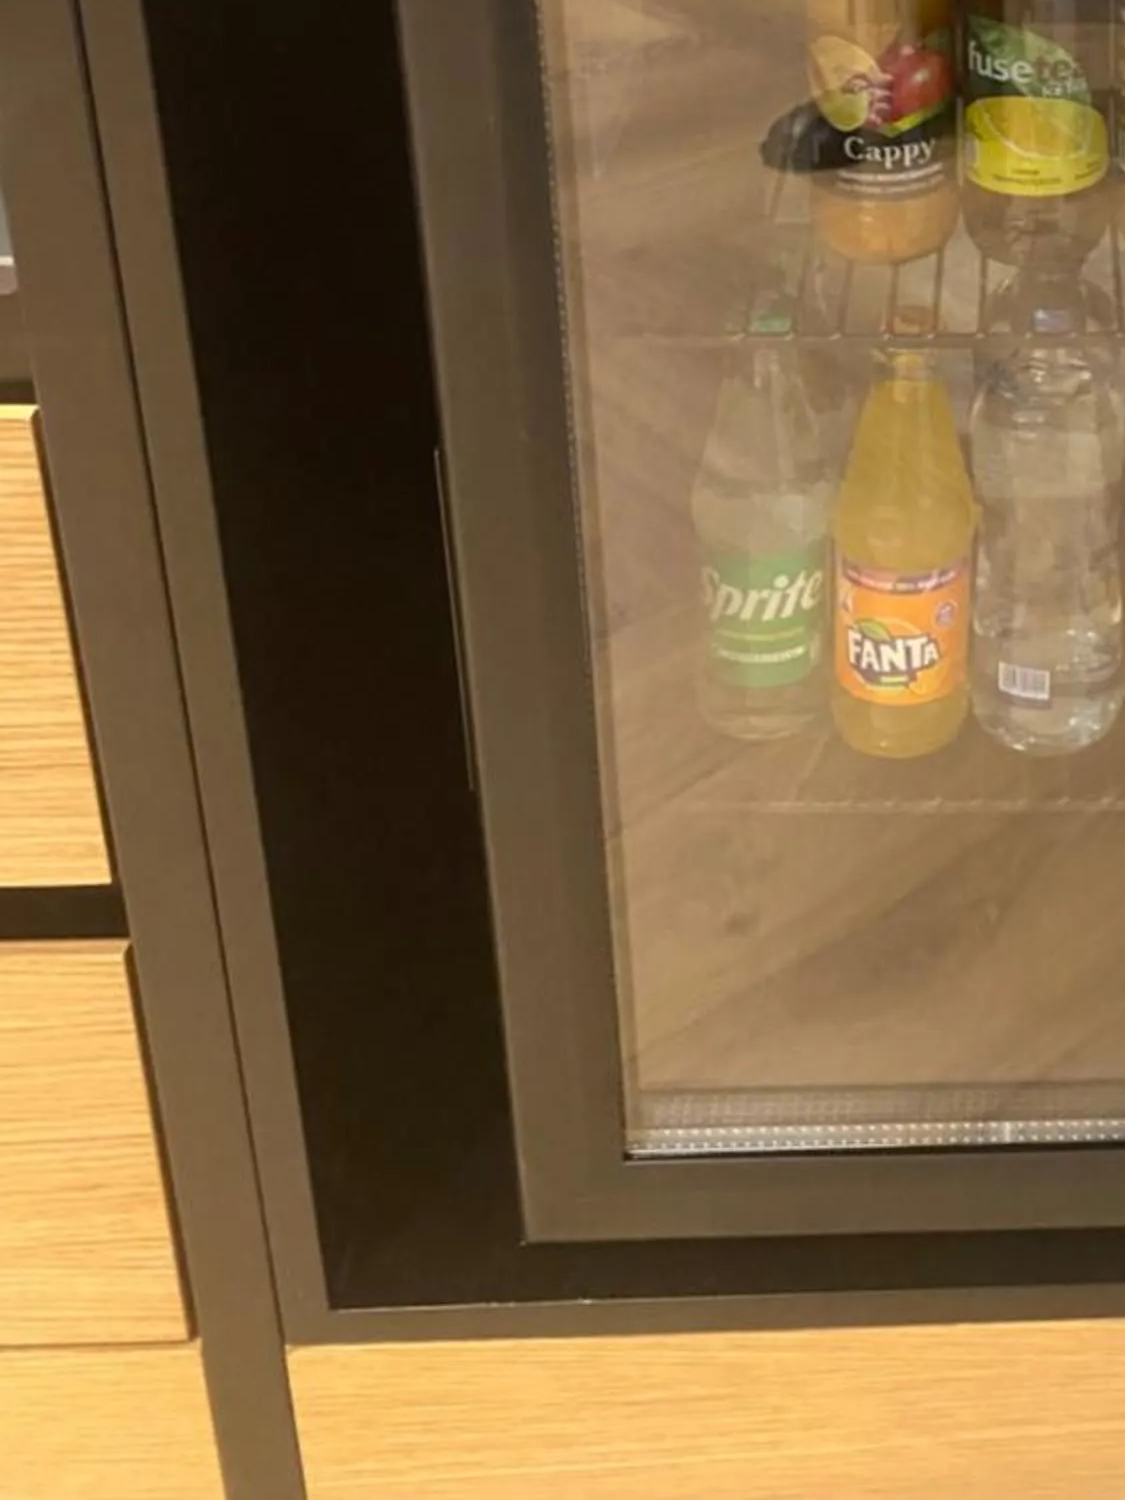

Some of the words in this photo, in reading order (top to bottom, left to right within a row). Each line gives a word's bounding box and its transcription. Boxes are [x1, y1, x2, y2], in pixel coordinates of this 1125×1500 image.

[844, 136, 937, 170] Cappy
[700, 565, 824, 622] Sprite
[847, 629, 940, 672] FANTA
